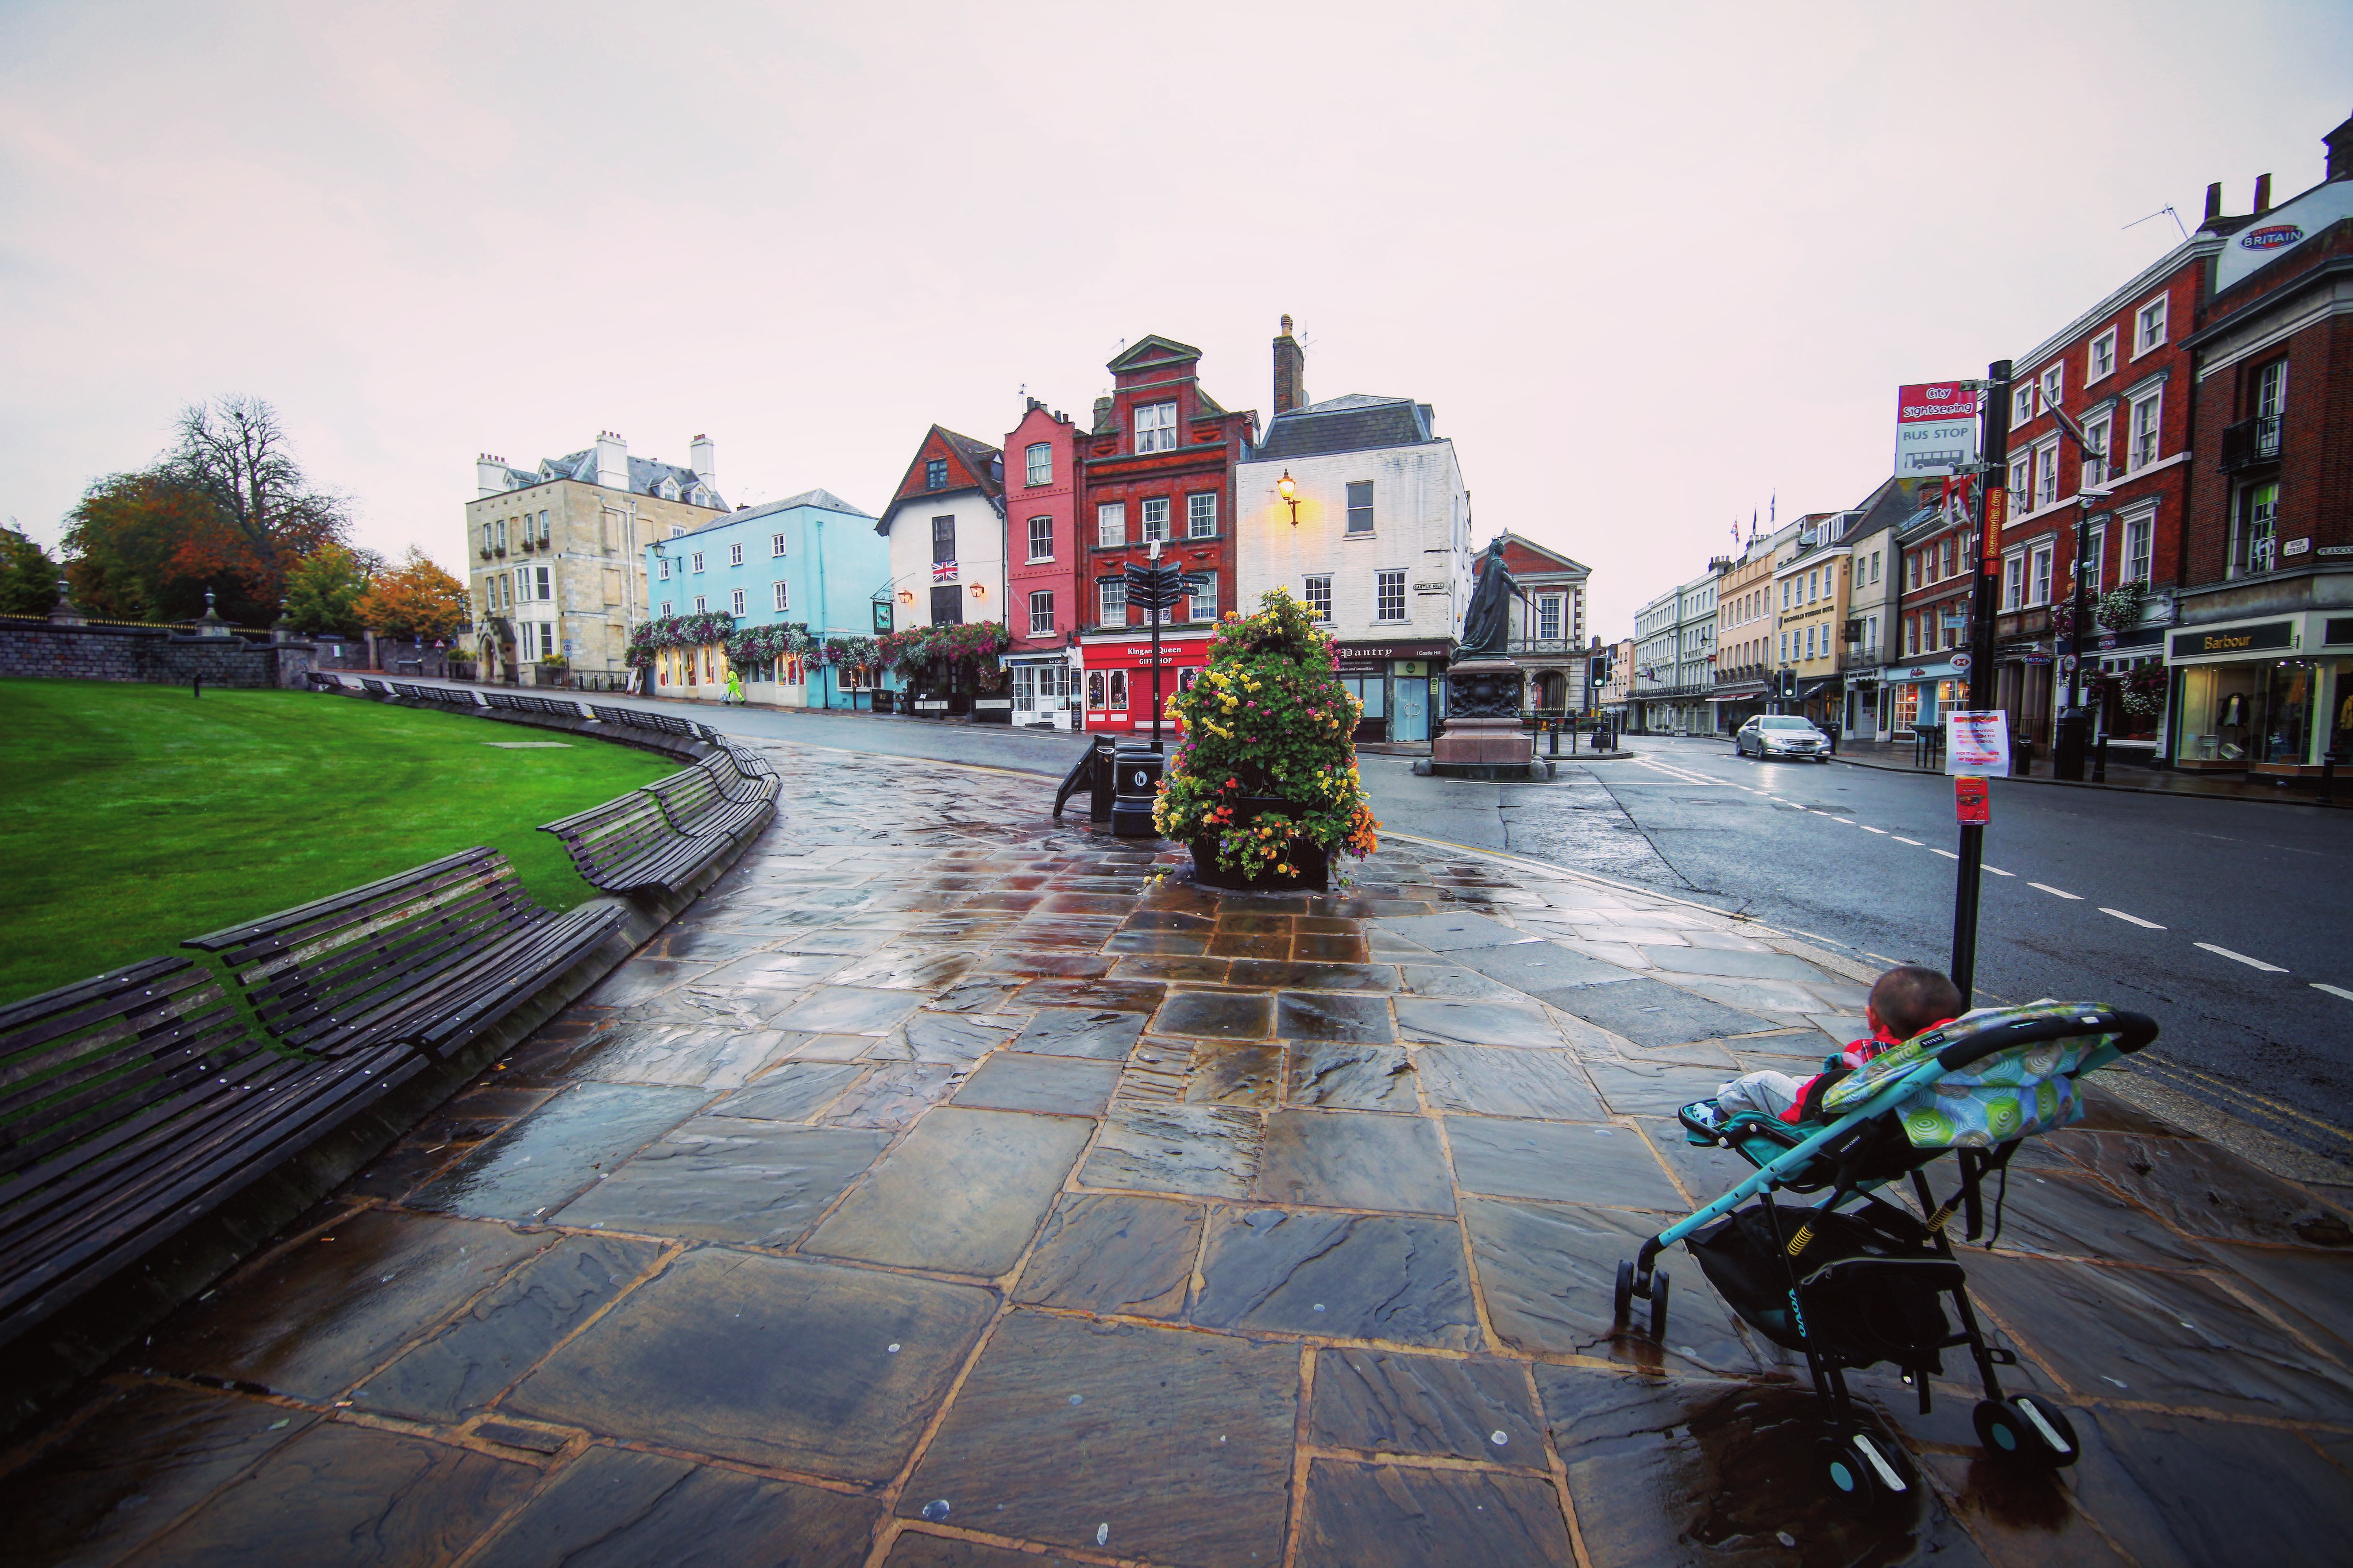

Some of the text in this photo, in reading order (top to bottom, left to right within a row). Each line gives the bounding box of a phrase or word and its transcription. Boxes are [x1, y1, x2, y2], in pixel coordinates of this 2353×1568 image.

[2252, 226, 2296, 235] GLORIOUS
[2244, 231, 2301, 246] BRITAIN
[1926, 388, 1951, 399] City
[1903, 403, 1973, 418] Sightseeing
[1903, 427, 1969, 441] BUS STOP
[1986, 489, 2002, 556] City Sightseeing
[2287, 545, 2306, 555] STREET
[2099, 639, 2115, 647] BRITAIN
[2204, 635, 2252, 650] Barbour
[1340, 648, 1392, 658] Pantry
